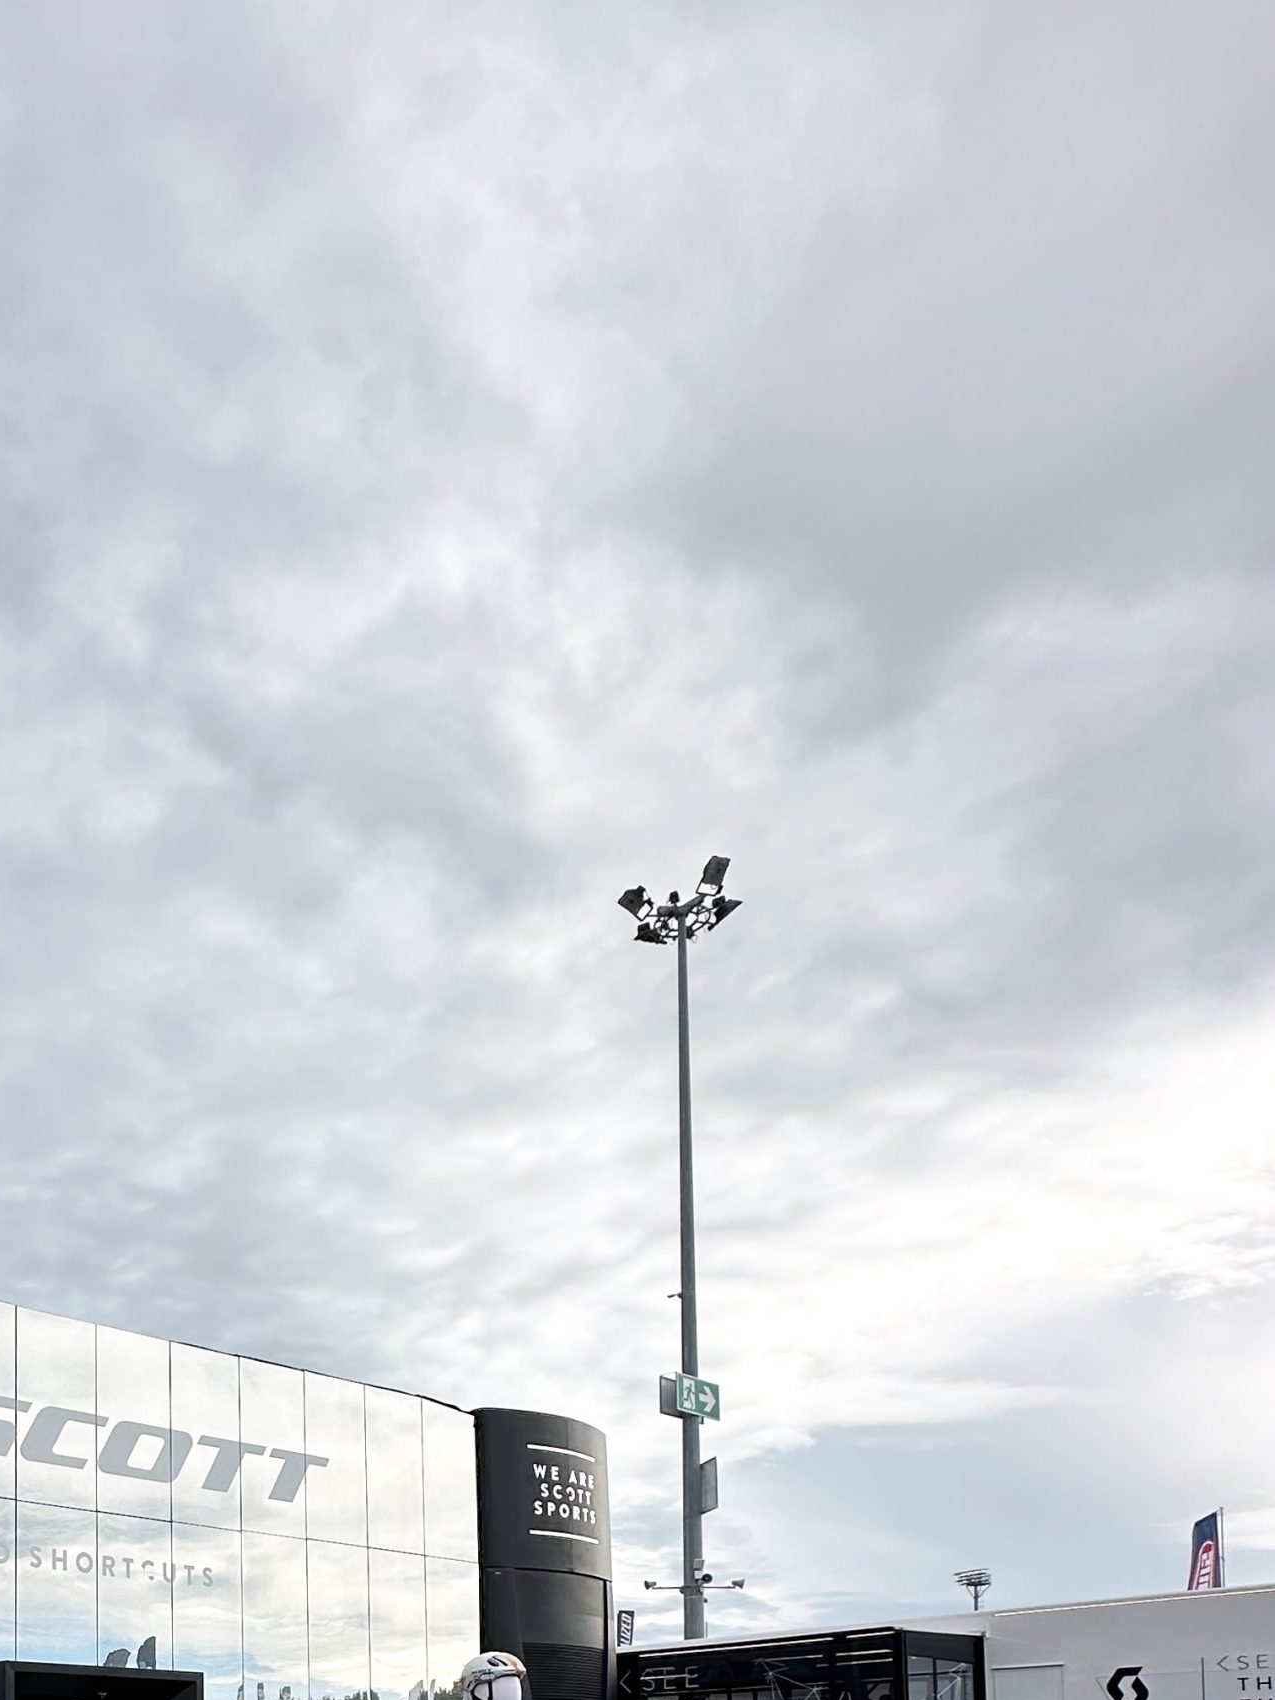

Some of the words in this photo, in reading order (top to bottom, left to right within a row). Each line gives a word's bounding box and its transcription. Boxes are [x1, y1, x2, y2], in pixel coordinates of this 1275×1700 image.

[532, 1463, 559, 1481] WE
[568, 1470, 594, 1490] ARE
[540, 1482, 592, 1505] SCOTT
[534, 1500, 596, 1525] SPORTS
[28, 1544, 213, 1588] SHORTCUTS
[640, 1666, 699, 1691] SEE
